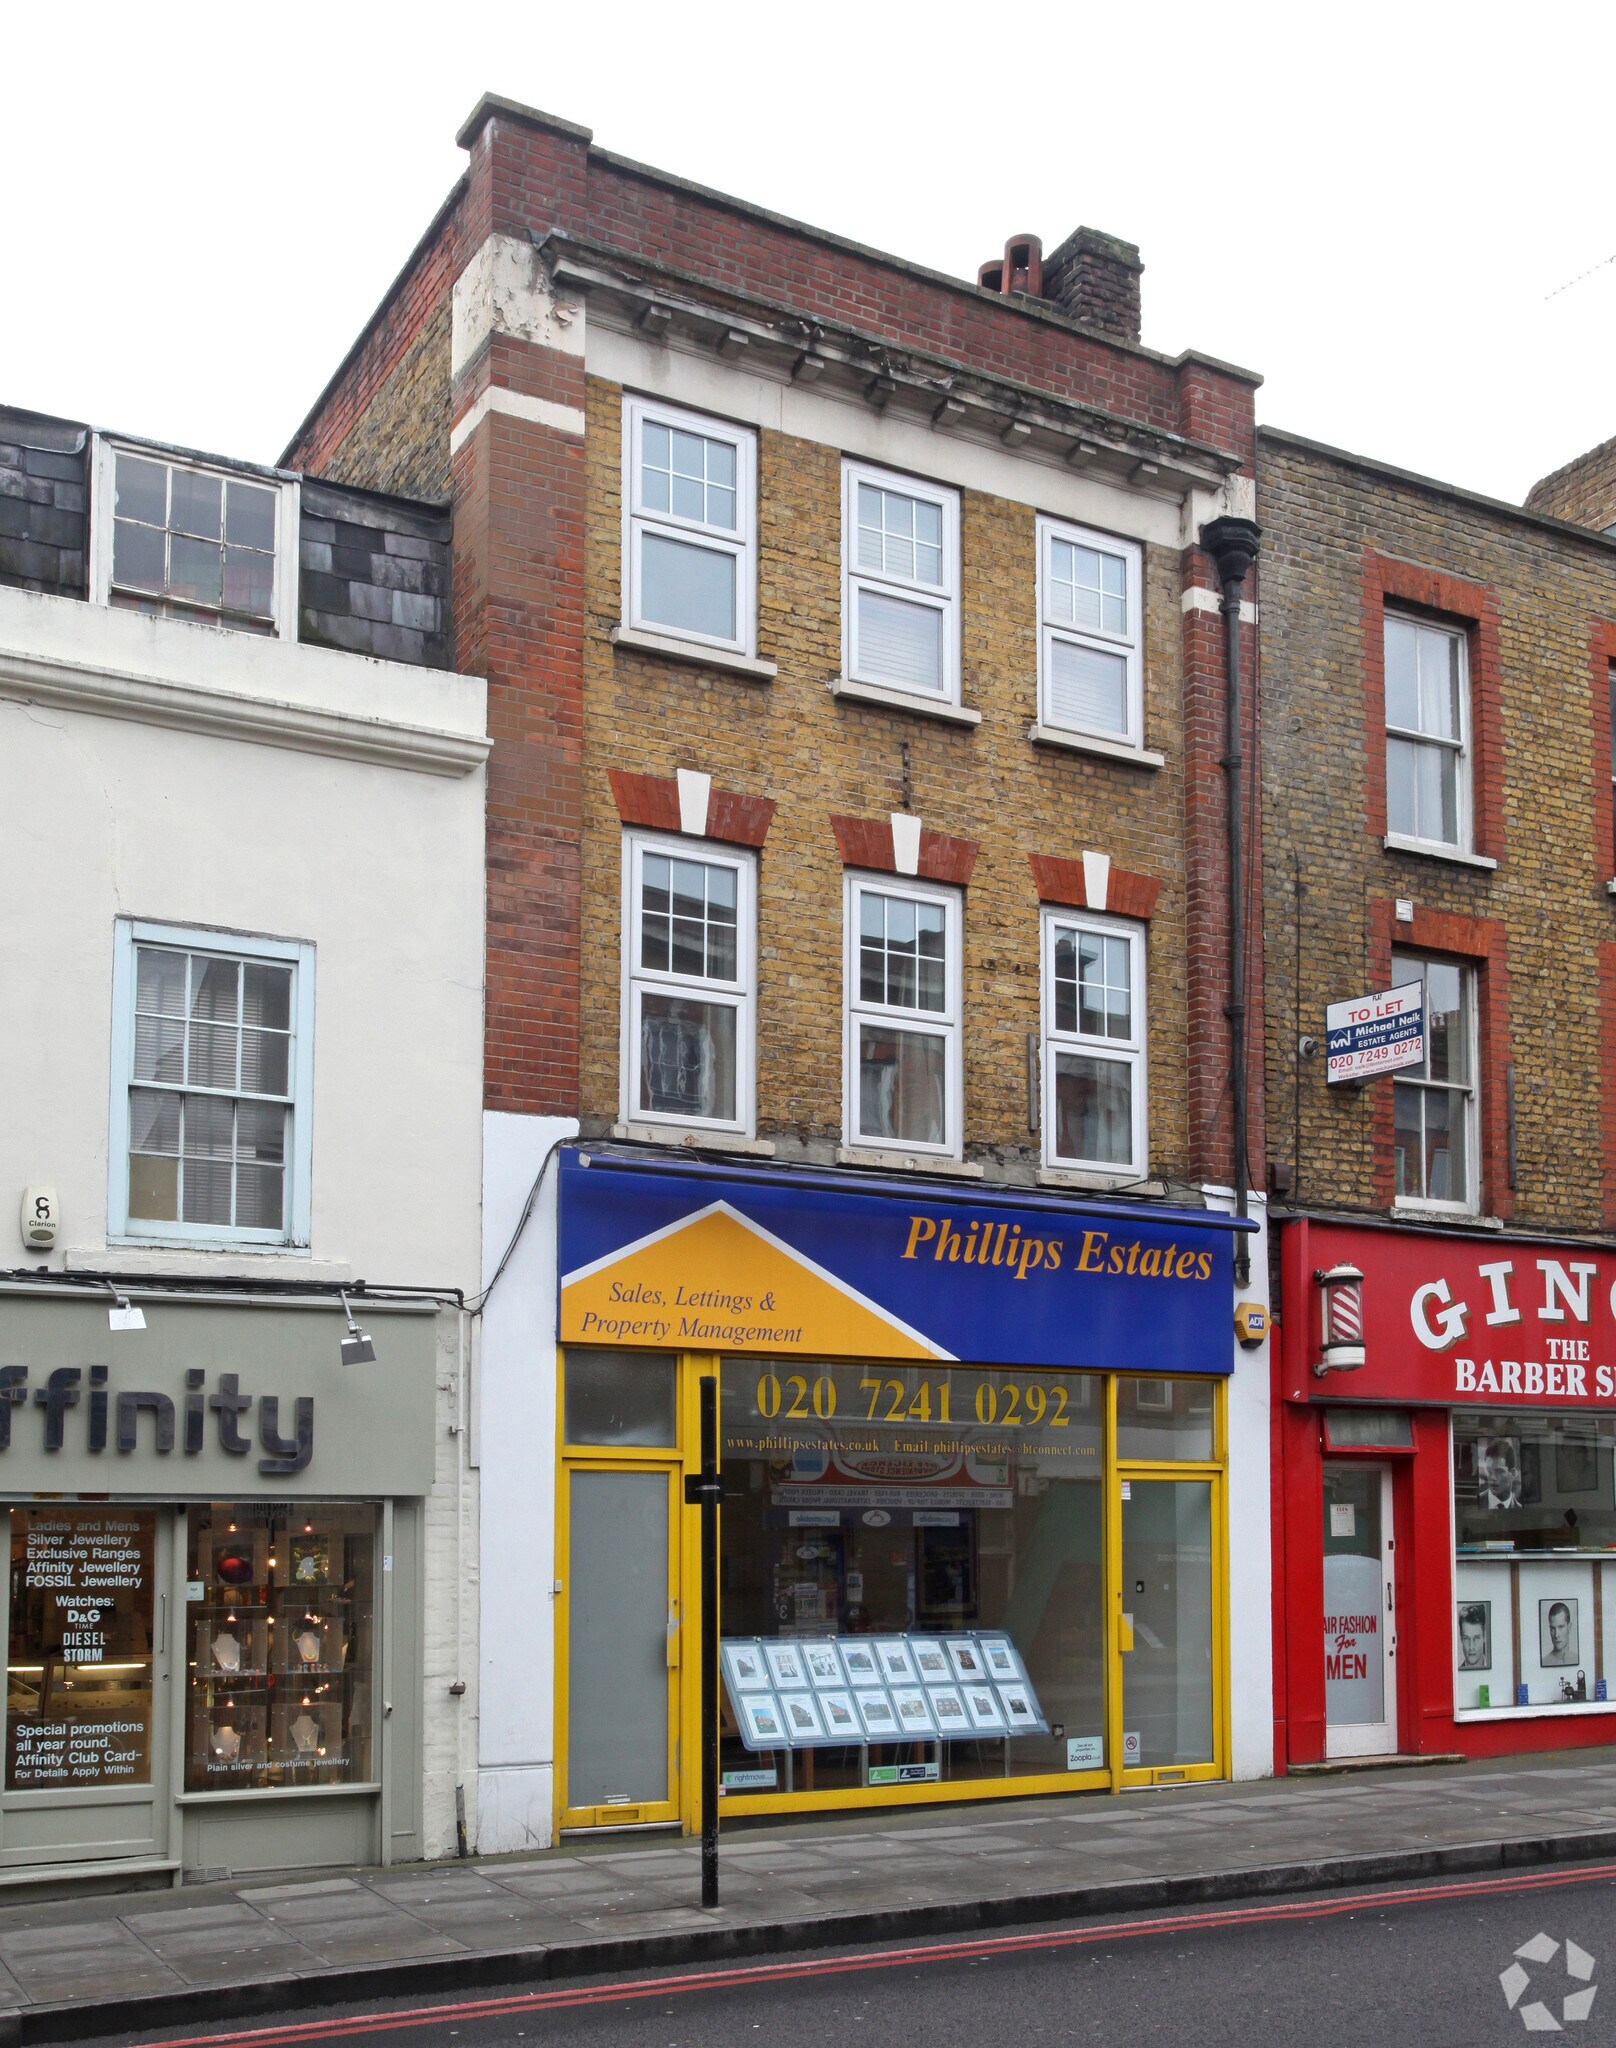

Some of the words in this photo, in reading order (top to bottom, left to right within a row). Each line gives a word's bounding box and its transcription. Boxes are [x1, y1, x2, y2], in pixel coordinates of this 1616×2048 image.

[1348, 1008, 1370, 1022] TO
[1376, 1000, 1403, 1018] LET
[1356, 1019, 1395, 1036] Michael
[1399, 1012, 1420, 1026] Naik
[1358, 1036, 1386, 1048] ESTATE
[1390, 1027, 1418, 1041] AGENTS
[1330, 1054, 1353, 1069] 020
[1358, 1047, 1388, 1064] 7249
[1394, 1038, 1421, 1056] 0272
[900, 1216, 1064, 1280] Phillips
[1074, 1230, 1213, 1280] Estates
[609, 1281, 667, 1308] Sales,
[674, 1286, 753, 1314] Lettings
[759, 1292, 776, 1312] &
[1410, 1258, 1616, 1351] GIN
[580, 1311, 671, 1341] Property
[677, 1317, 802, 1346] Management
[1249, 1316, 1264, 1328] ADT
[1546, 1338, 1590, 1361] THE
[1455, 1358, 1588, 1396] BARBER
[1596, 1365, 1616, 1398] S
[756, 1374, 837, 1420] 020
[859, 1378, 954, 1424] 7241
[975, 1382, 1070, 1427] 0292
[727, 1436, 880, 1452] www.phillipsestates.co.uk
[894, 1440, 928, 1452] Email
[934, 1441, 1096, 1456] phillipsestates@btconnect.com
[28, 1520, 72, 1532] Ladies
[77, 1520, 100, 1532] and
[106, 1520, 140, 1532] Mens
[27, 1534, 64, 1546] Silver
[69, 1534, 131, 1548] Jewellery
[26, 1548, 88, 1558] Exclusive
[92, 1548, 140, 1561] Ranges
[26, 1561, 74, 1575] Affinity
[78, 1561, 140, 1575] Jewellery
[26, 1575, 76, 1587] FOSSIL
[80, 1576, 142, 1588] Jewellery
[56, 1596, 114, 1606] Watches:
[68, 1610, 100, 1622] D&G
[1339, 1615, 1376, 1634] FASHION
[63, 1632, 106, 1646] DIESEL
[1334, 1634, 1356, 1654] For
[64, 1648, 103, 1662] STORM
[1326, 1654, 1366, 1680] MEN
[16, 1724, 66, 1738] Special
[70, 1722, 144, 1736] promotions
[16, 1740, 32, 1752] all
[36, 1740, 66, 1753] year
[70, 1737, 111, 1749] round.
[16, 1754, 64, 1766] Affinity
[68, 1752, 99, 1764] Club
[104, 1750, 142, 1762] Card-
[275, 1760, 310, 1768] costume
[313, 1758, 350, 1768] jewellery
[14, 1770, 32, 1778] For
[34, 1768, 68, 1778] Details
[72, 1766, 100, 1777] Apply
[104, 1764, 134, 1774] Within
